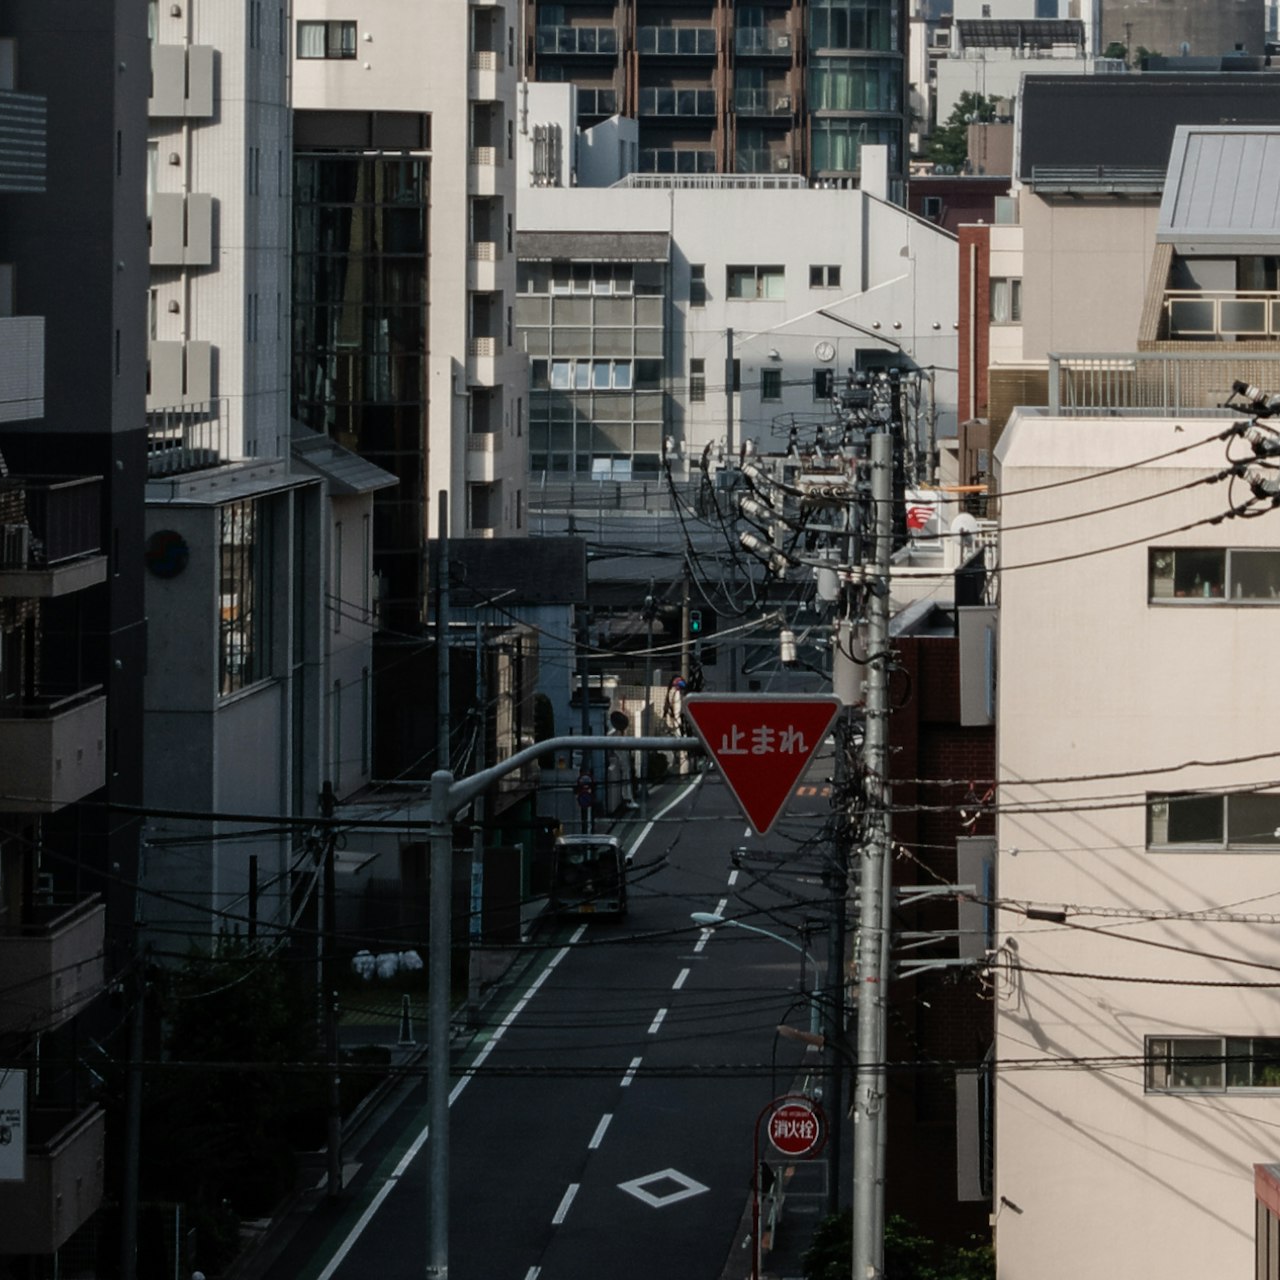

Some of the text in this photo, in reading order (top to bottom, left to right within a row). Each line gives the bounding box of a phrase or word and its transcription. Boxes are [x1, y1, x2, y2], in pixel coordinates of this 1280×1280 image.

[716, 723, 809, 756] 止まれ
[773, 1119, 814, 1139] 消火栓
